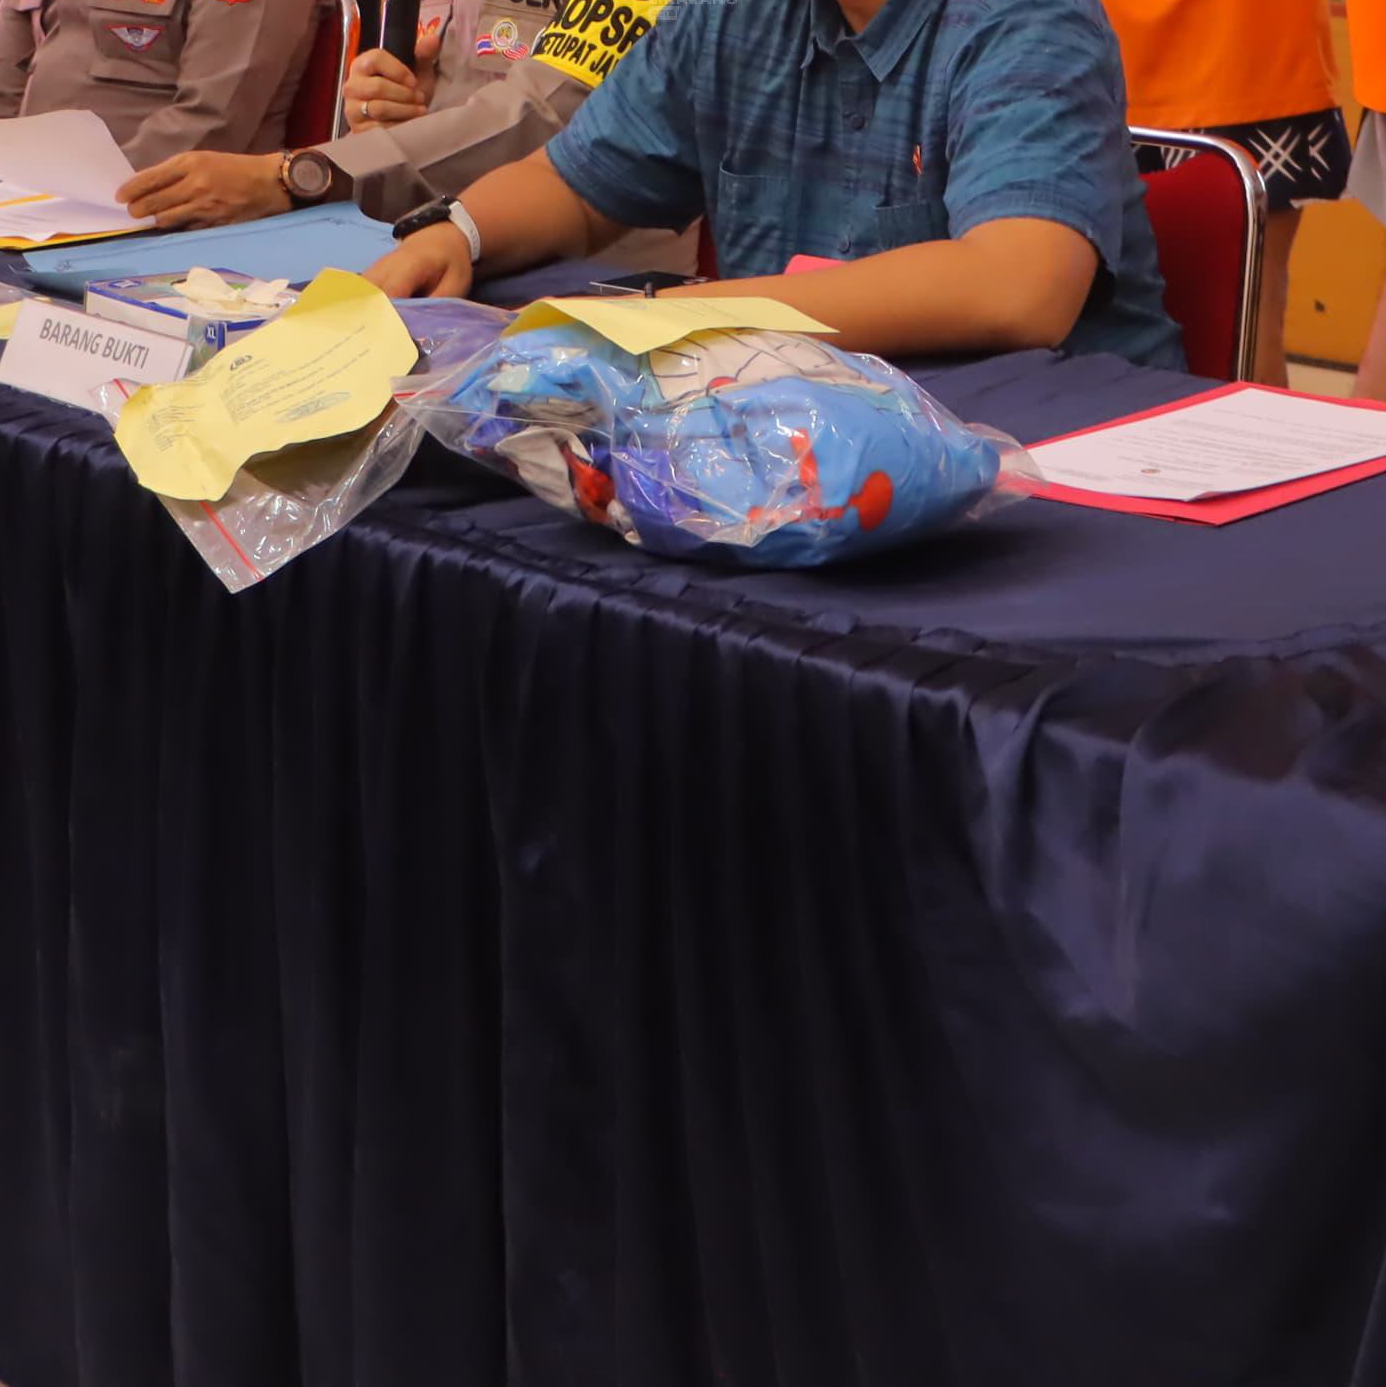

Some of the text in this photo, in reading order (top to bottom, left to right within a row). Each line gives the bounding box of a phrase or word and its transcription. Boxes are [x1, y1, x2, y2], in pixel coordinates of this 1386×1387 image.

[39, 317, 151, 370] BARANG BUKTI
[206, 324, 217, 340] XL
